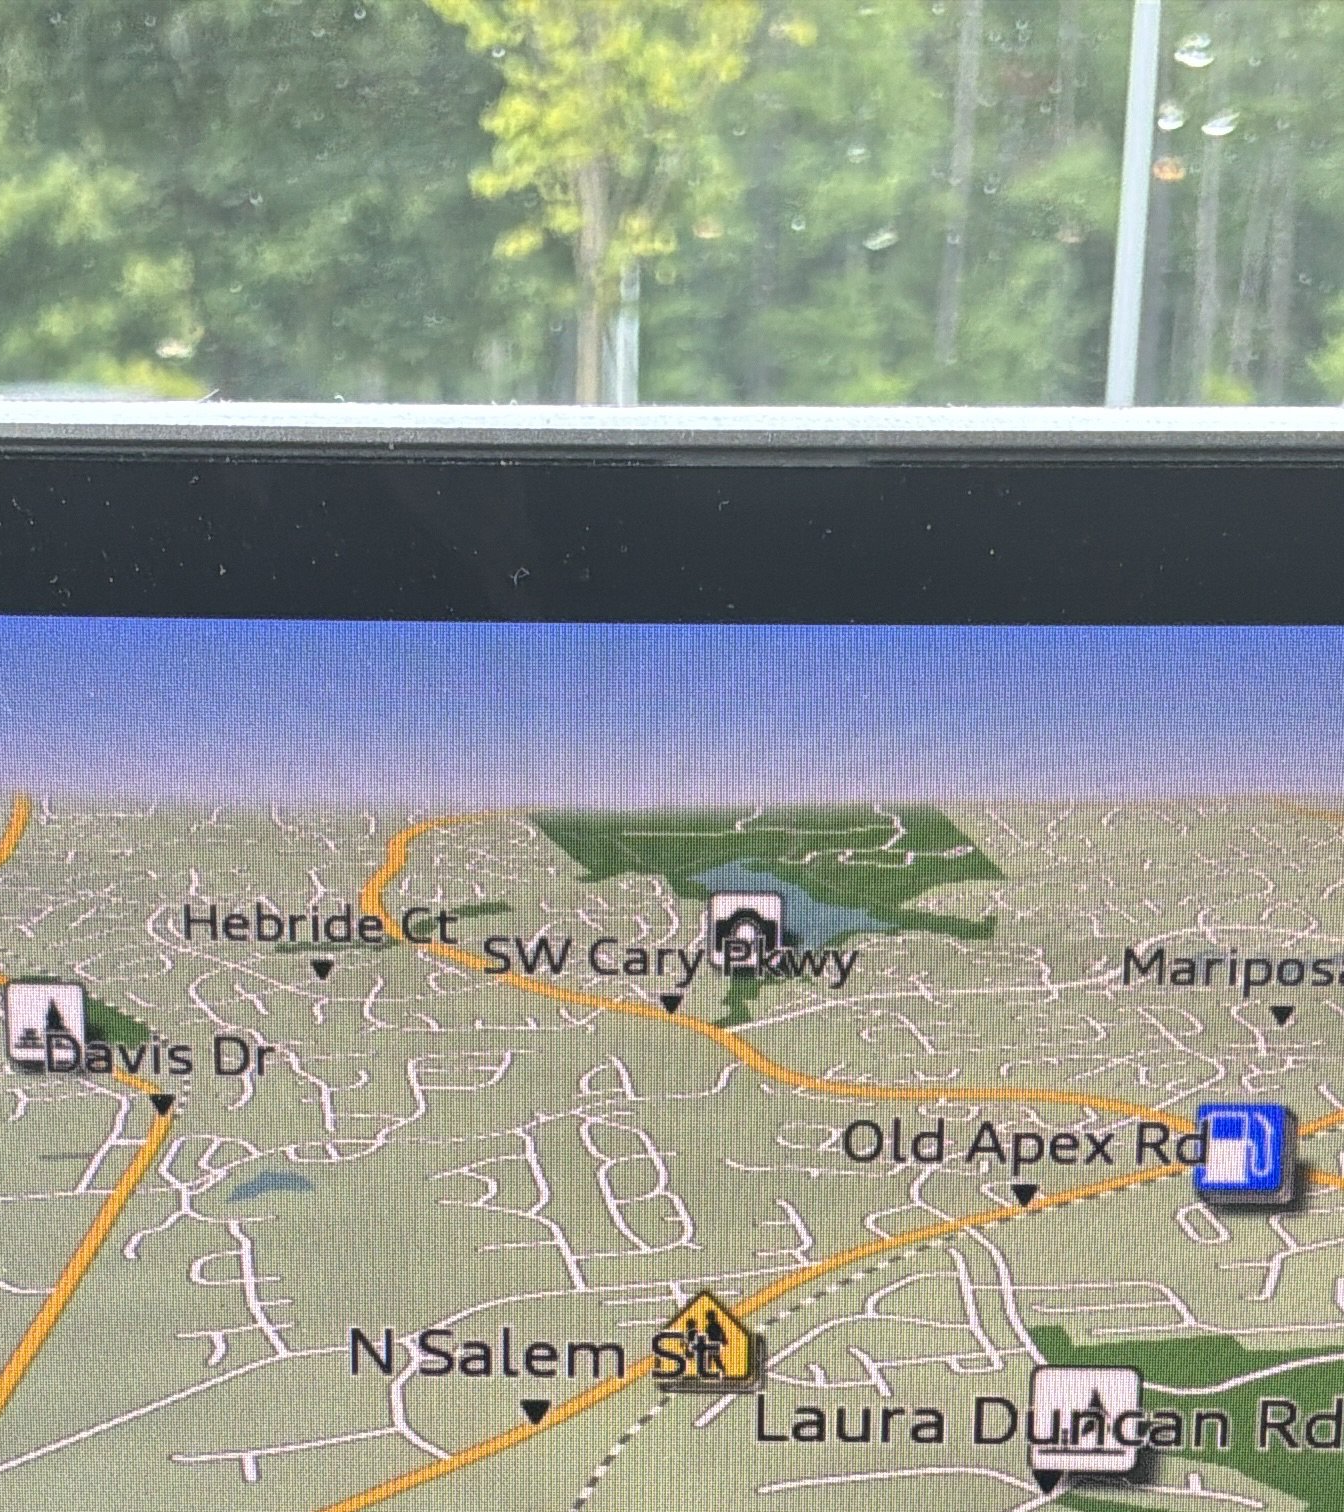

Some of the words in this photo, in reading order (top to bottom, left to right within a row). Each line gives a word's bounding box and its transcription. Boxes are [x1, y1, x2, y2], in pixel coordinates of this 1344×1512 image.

[182, 902, 384, 944] Hebride
[401, 905, 458, 944] Ct
[482, 934, 572, 976] SW
[588, 936, 706, 988] Cary
[722, 935, 859, 990] Pkwy
[45, 1032, 193, 1075] Davis
[214, 1036, 274, 1076] Dr
[843, 1117, 945, 1164] Old
[966, 1120, 1114, 1176] Apex
[1136, 1121, 1208, 1166] Rd
[350, 1328, 393, 1376] N
[419, 1327, 624, 1377] Salem
[653, 1332, 721, 1379] St
[756, 1396, 944, 1445] Laura
[974, 1398, 1229, 1448] Duncan
[1260, 1399, 1343, 1450] Rd
